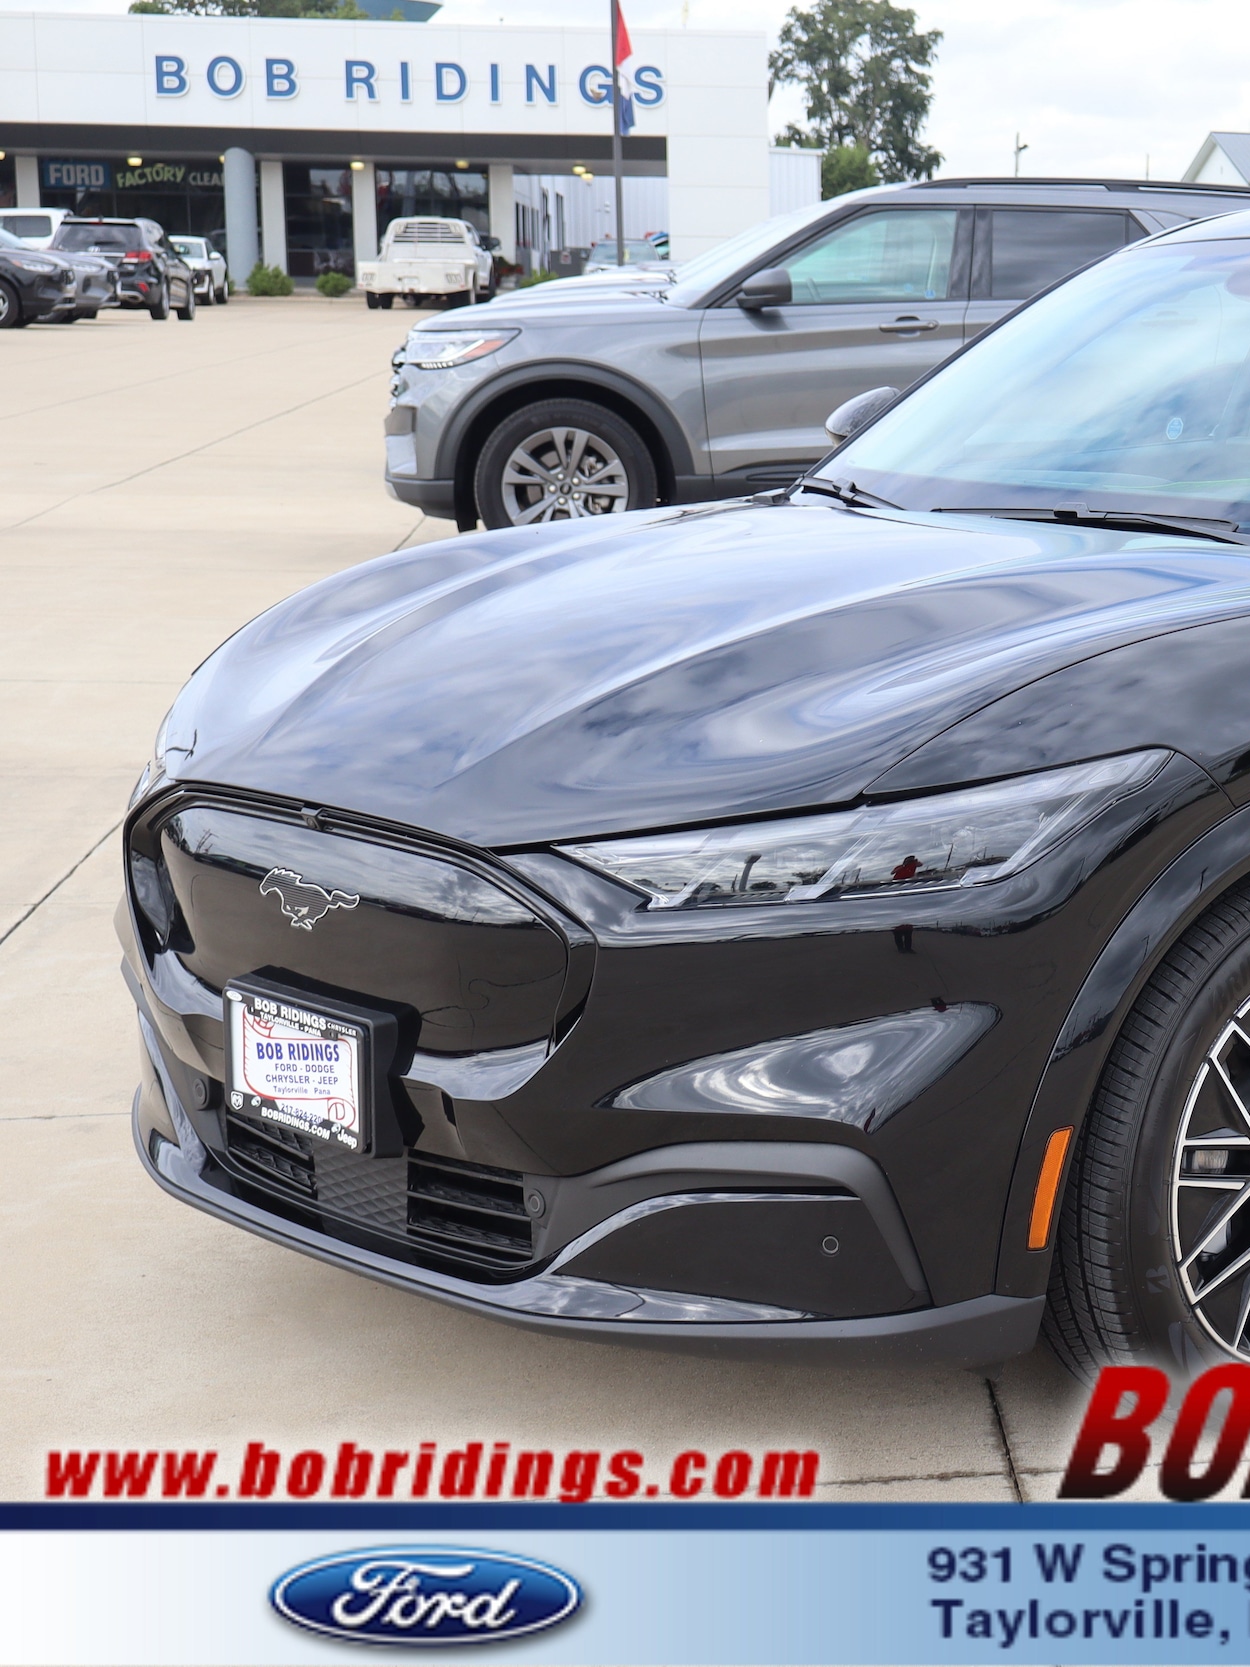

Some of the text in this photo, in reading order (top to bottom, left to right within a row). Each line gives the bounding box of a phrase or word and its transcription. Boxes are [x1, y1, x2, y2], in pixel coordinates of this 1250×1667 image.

[154, 55, 668, 108] BOB RIDINGS
[49, 164, 105, 186] FORD
[116, 163, 186, 188] FACTORY
[254, 997, 327, 1030] BOB RIDINGS
[260, 1011, 299, 1030] TAYLORVILLE
[304, 1026, 322, 1037] PANA
[327, 1022, 357, 1037] CHRYSLER
[256, 1042, 340, 1062] BOB RIDINGS
[265, 1074, 310, 1084] CHRYSLER
[317, 1076, 339, 1085] JEEP
[275, 1063, 298, 1072] FORD
[305, 1064, 335, 1074] DODGE
[273, 1085, 331, 1095] Taylorville Pana
[261, 1106, 331, 1140] BOBRIDINGS.COM
[337, 1128, 358, 1150] Jeep
